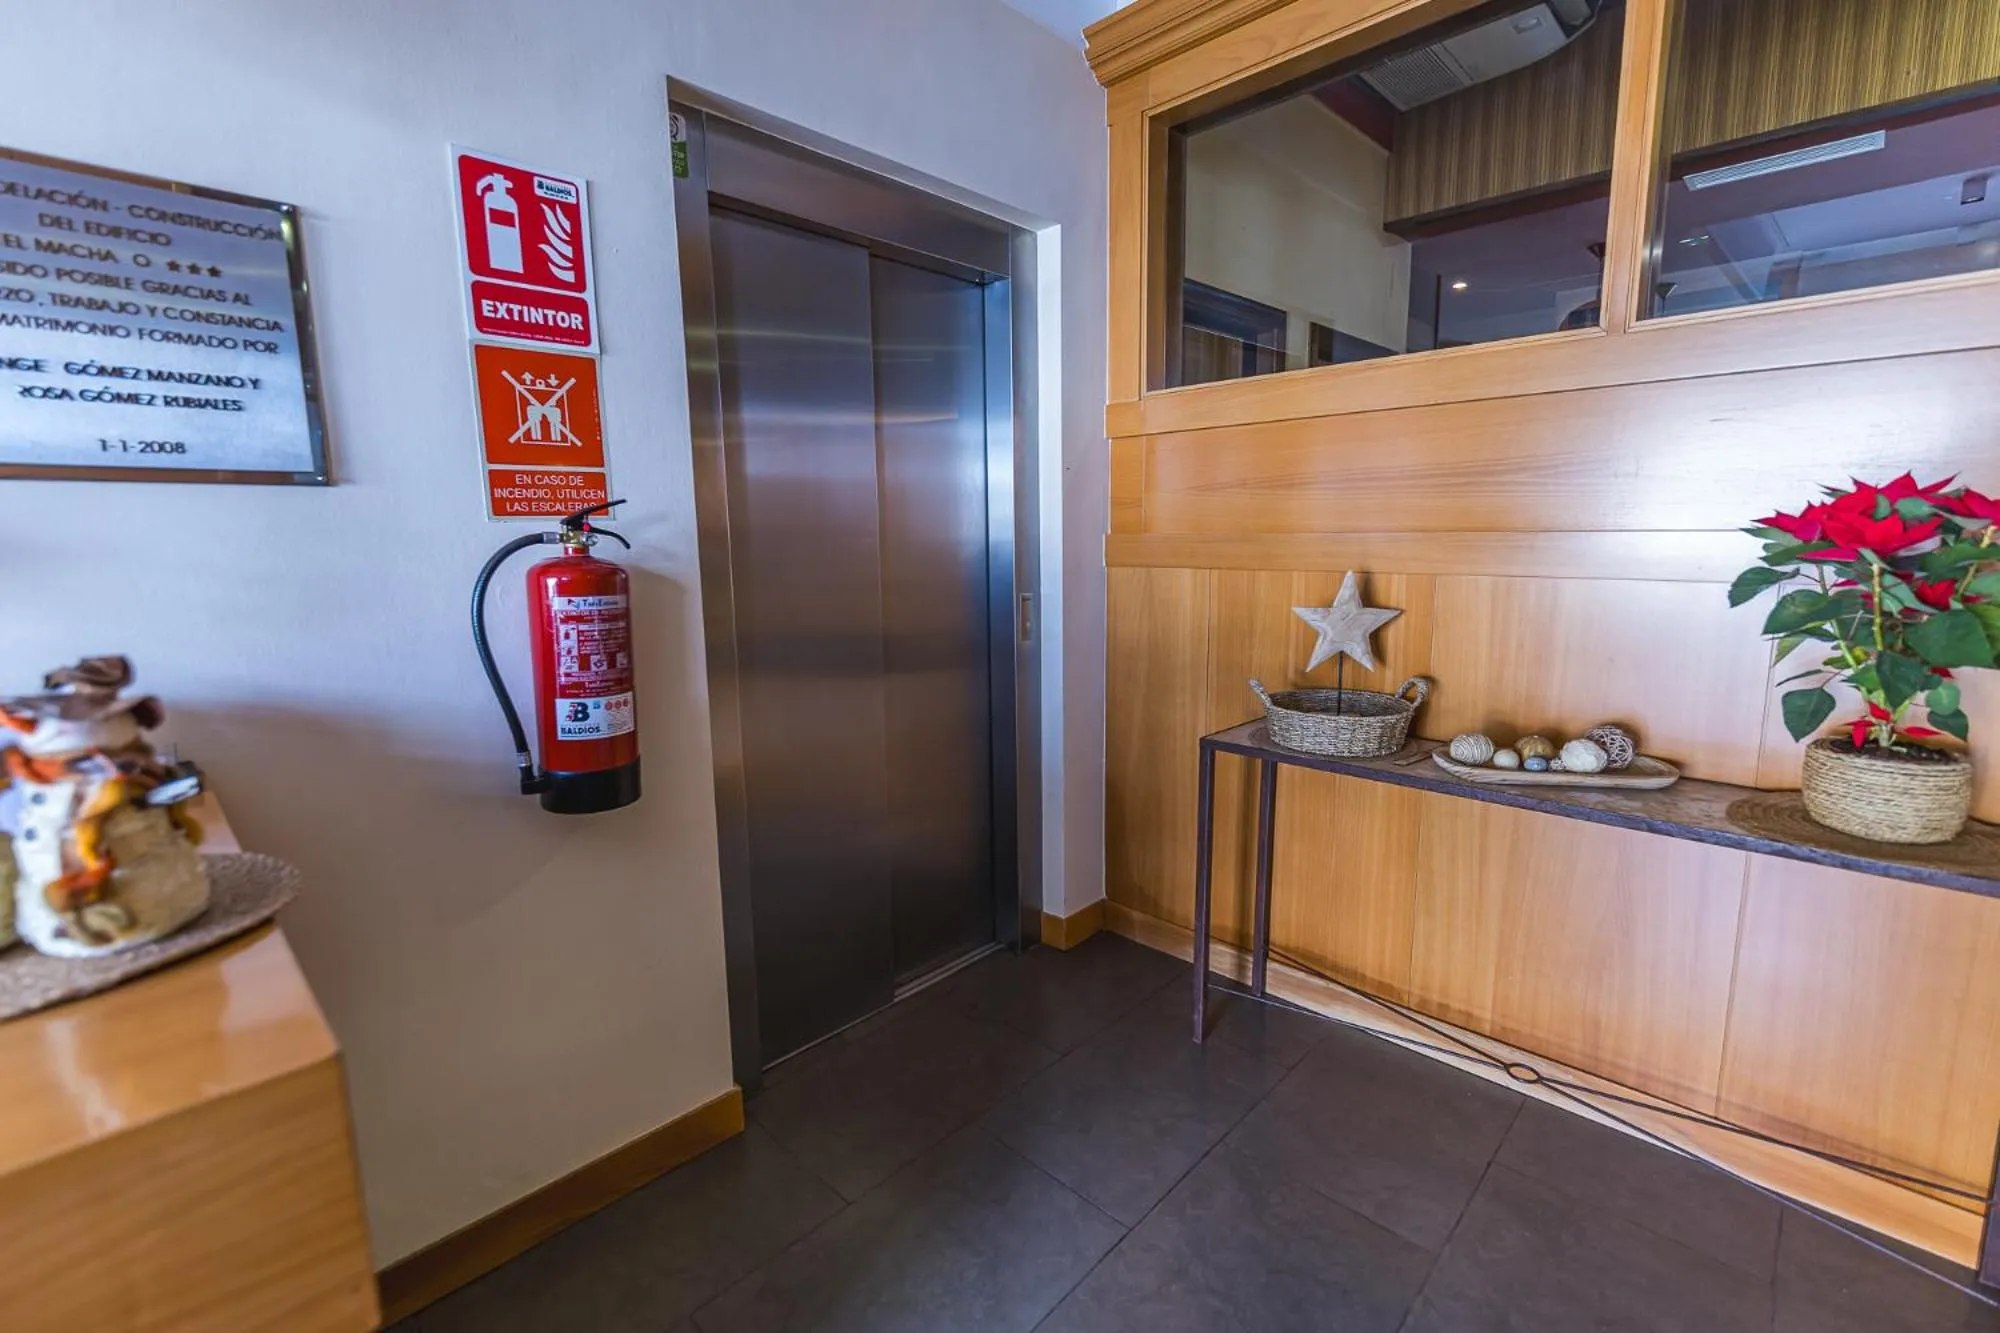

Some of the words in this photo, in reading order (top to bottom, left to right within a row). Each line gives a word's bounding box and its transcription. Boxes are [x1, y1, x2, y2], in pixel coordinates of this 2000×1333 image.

[38, 212, 79, 232] DEL
[84, 220, 172, 246] EDIFICIO
[128, 204, 284, 242] CONSTRUCCIÓN
[56, 268, 137, 290] POSIBLE
[141, 280, 227, 302] GRACIAS
[232, 292, 254, 306] AL
[48, 292, 141, 316] TRABAJO
[146, 304, 158, 318] Y
[162, 306, 285, 332] CONSTANCIA
[481, 299, 584, 330] EXTINTOR
[138, 328, 238, 350] FORMADO
[243, 339, 279, 354] POR
[64, 359, 141, 381] GÓMEZ
[147, 368, 246, 389] MANZANO
[247, 377, 262, 390] Y
[79, 386, 156, 406] GÓMEZ
[98, 439, 187, 454] 1-1-2008
[515, 474, 532, 485] EN
[534, 475, 566, 486] CASO
[569, 476, 585, 486] DE
[506, 502, 529, 512] LAS
[557, 489, 605, 500] UTILICEN
